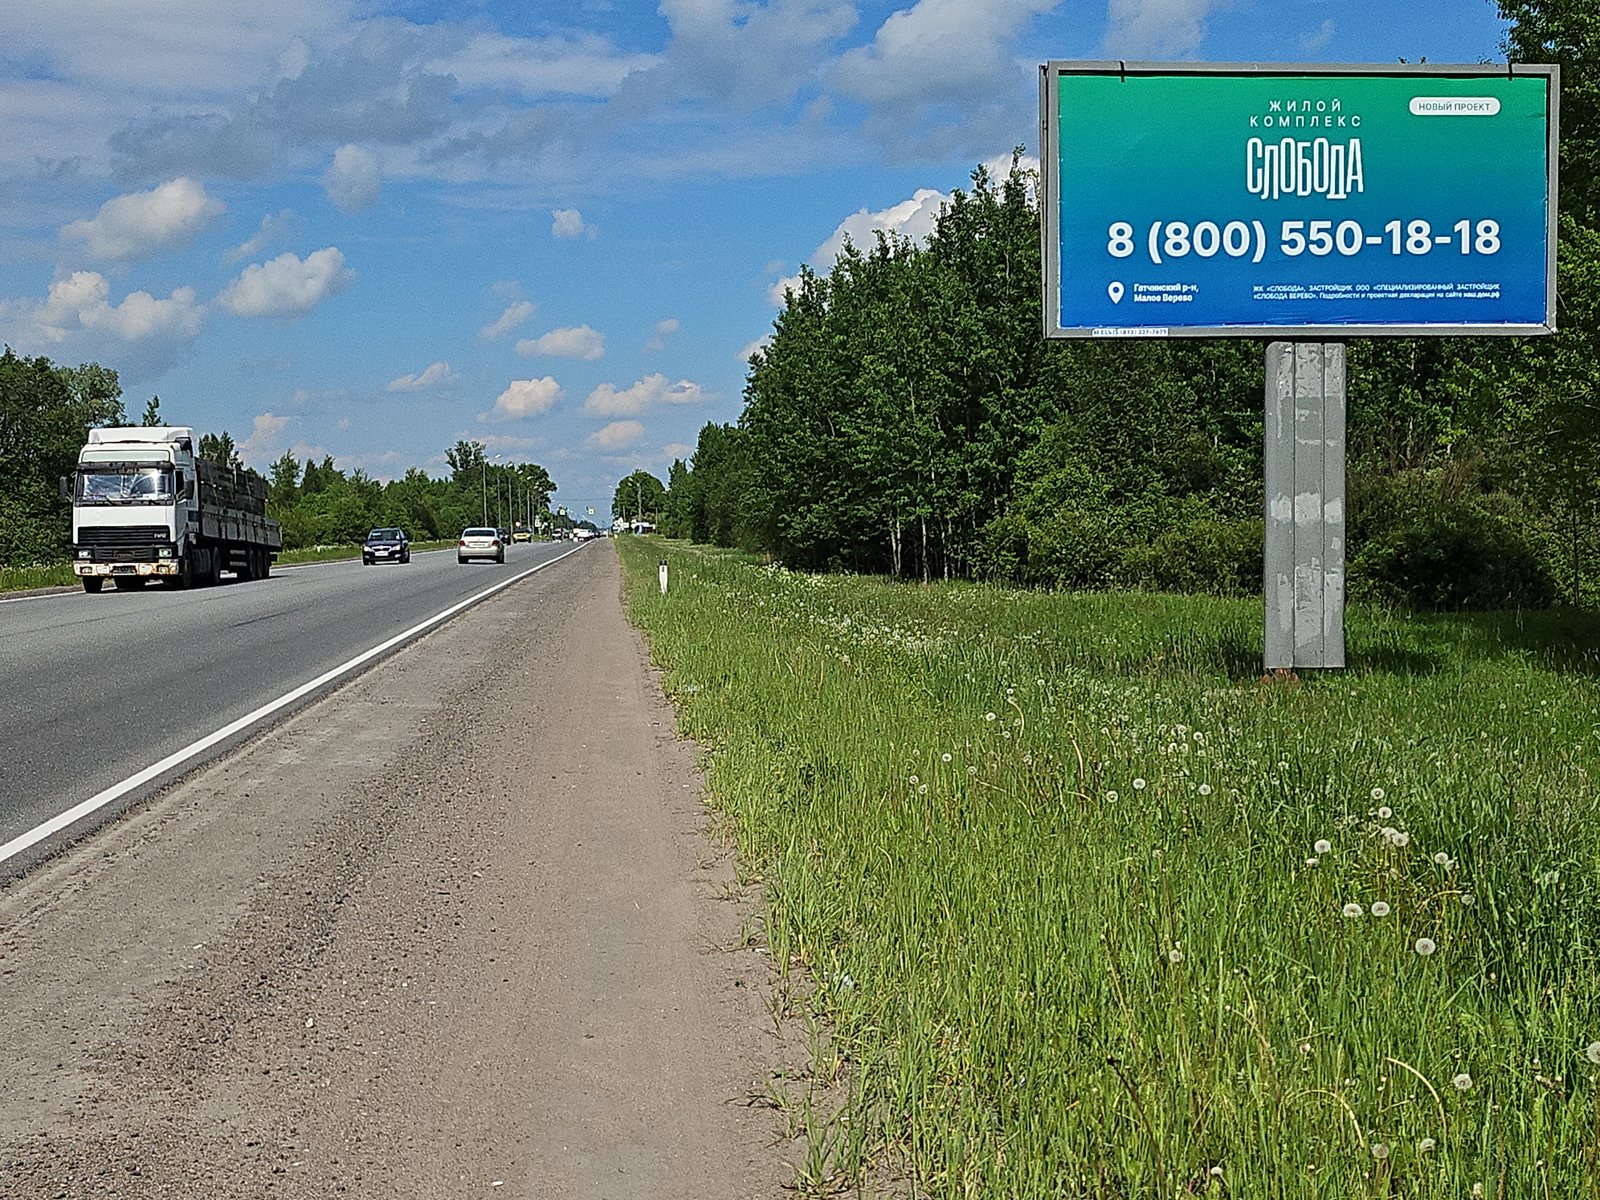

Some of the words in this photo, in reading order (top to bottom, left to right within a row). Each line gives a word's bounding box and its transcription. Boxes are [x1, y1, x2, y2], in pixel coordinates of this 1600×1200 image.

[1269, 98, 1342, 113] ЖИЛОЙ
[1418, 101, 1452, 112] НОВЫЙ
[1454, 102, 1491, 112] ПРОЕКТ
[1250, 115, 1361, 127] КОМПЛЕКС
[1246, 137, 1364, 200] СЛОБОДА
[1107, 221, 1135, 258] 8
[1148, 220, 1267, 264] (800)
[1280, 219, 1501, 257] 550-18-18
[1133, 283, 1181, 292] Гатчинский
[1182, 284, 1200, 293] р-н,
[1308, 283, 1353, 292] ЗАСТРОЙЩИК
[1456, 282, 1501, 291] ЗАСТРОЙЩИК
[1133, 293, 1162, 303] Малое
[1162, 293, 1193, 304] Верево
[1253, 292, 1288, 300] «СЛОБОДА
[1319, 292, 1360, 300] Подробности
[1366, 292, 1398, 300] проектная
[1398, 292, 1435, 300] декларация
